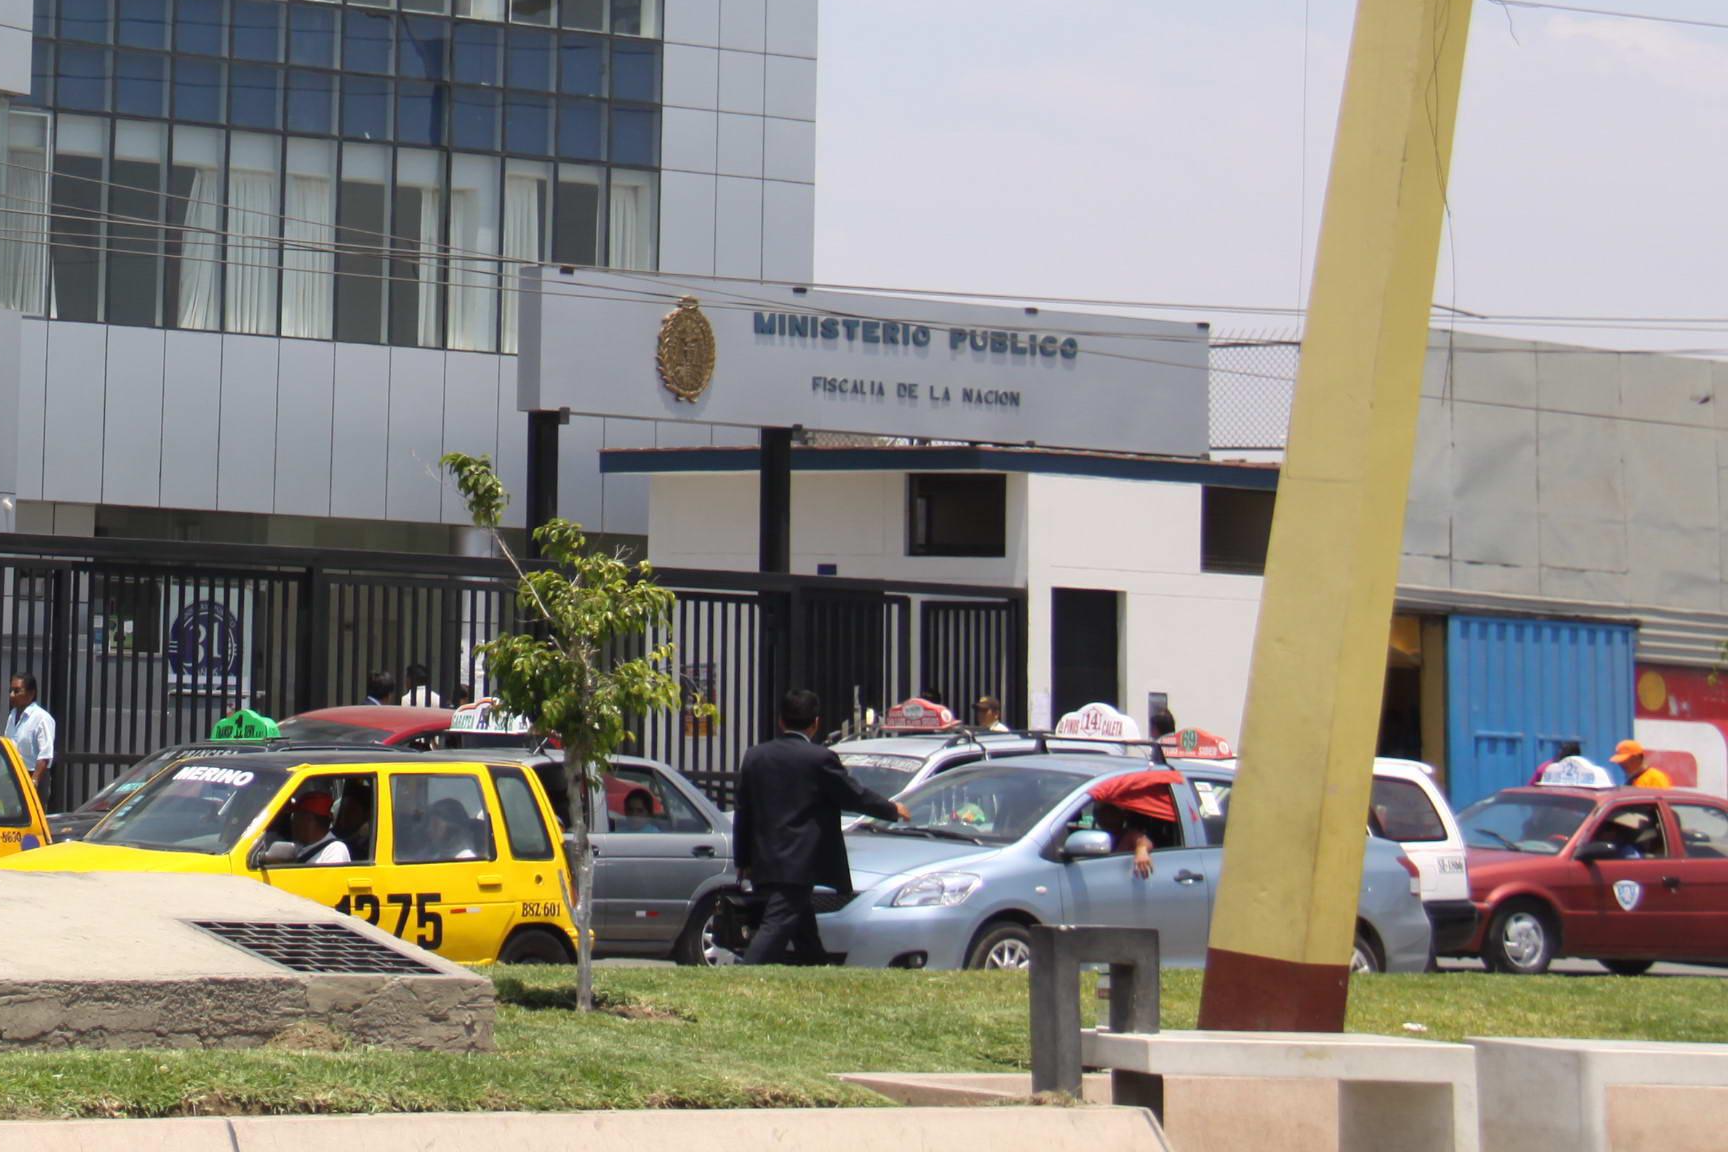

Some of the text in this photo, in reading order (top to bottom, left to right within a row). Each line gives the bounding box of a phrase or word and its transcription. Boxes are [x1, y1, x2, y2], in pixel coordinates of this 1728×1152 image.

[753, 311, 1079, 360] MINISTERIO PUBLICO
[811, 375, 1021, 407] FISCALIA DE LA NACION
[172, 766, 255, 787] MERINO
